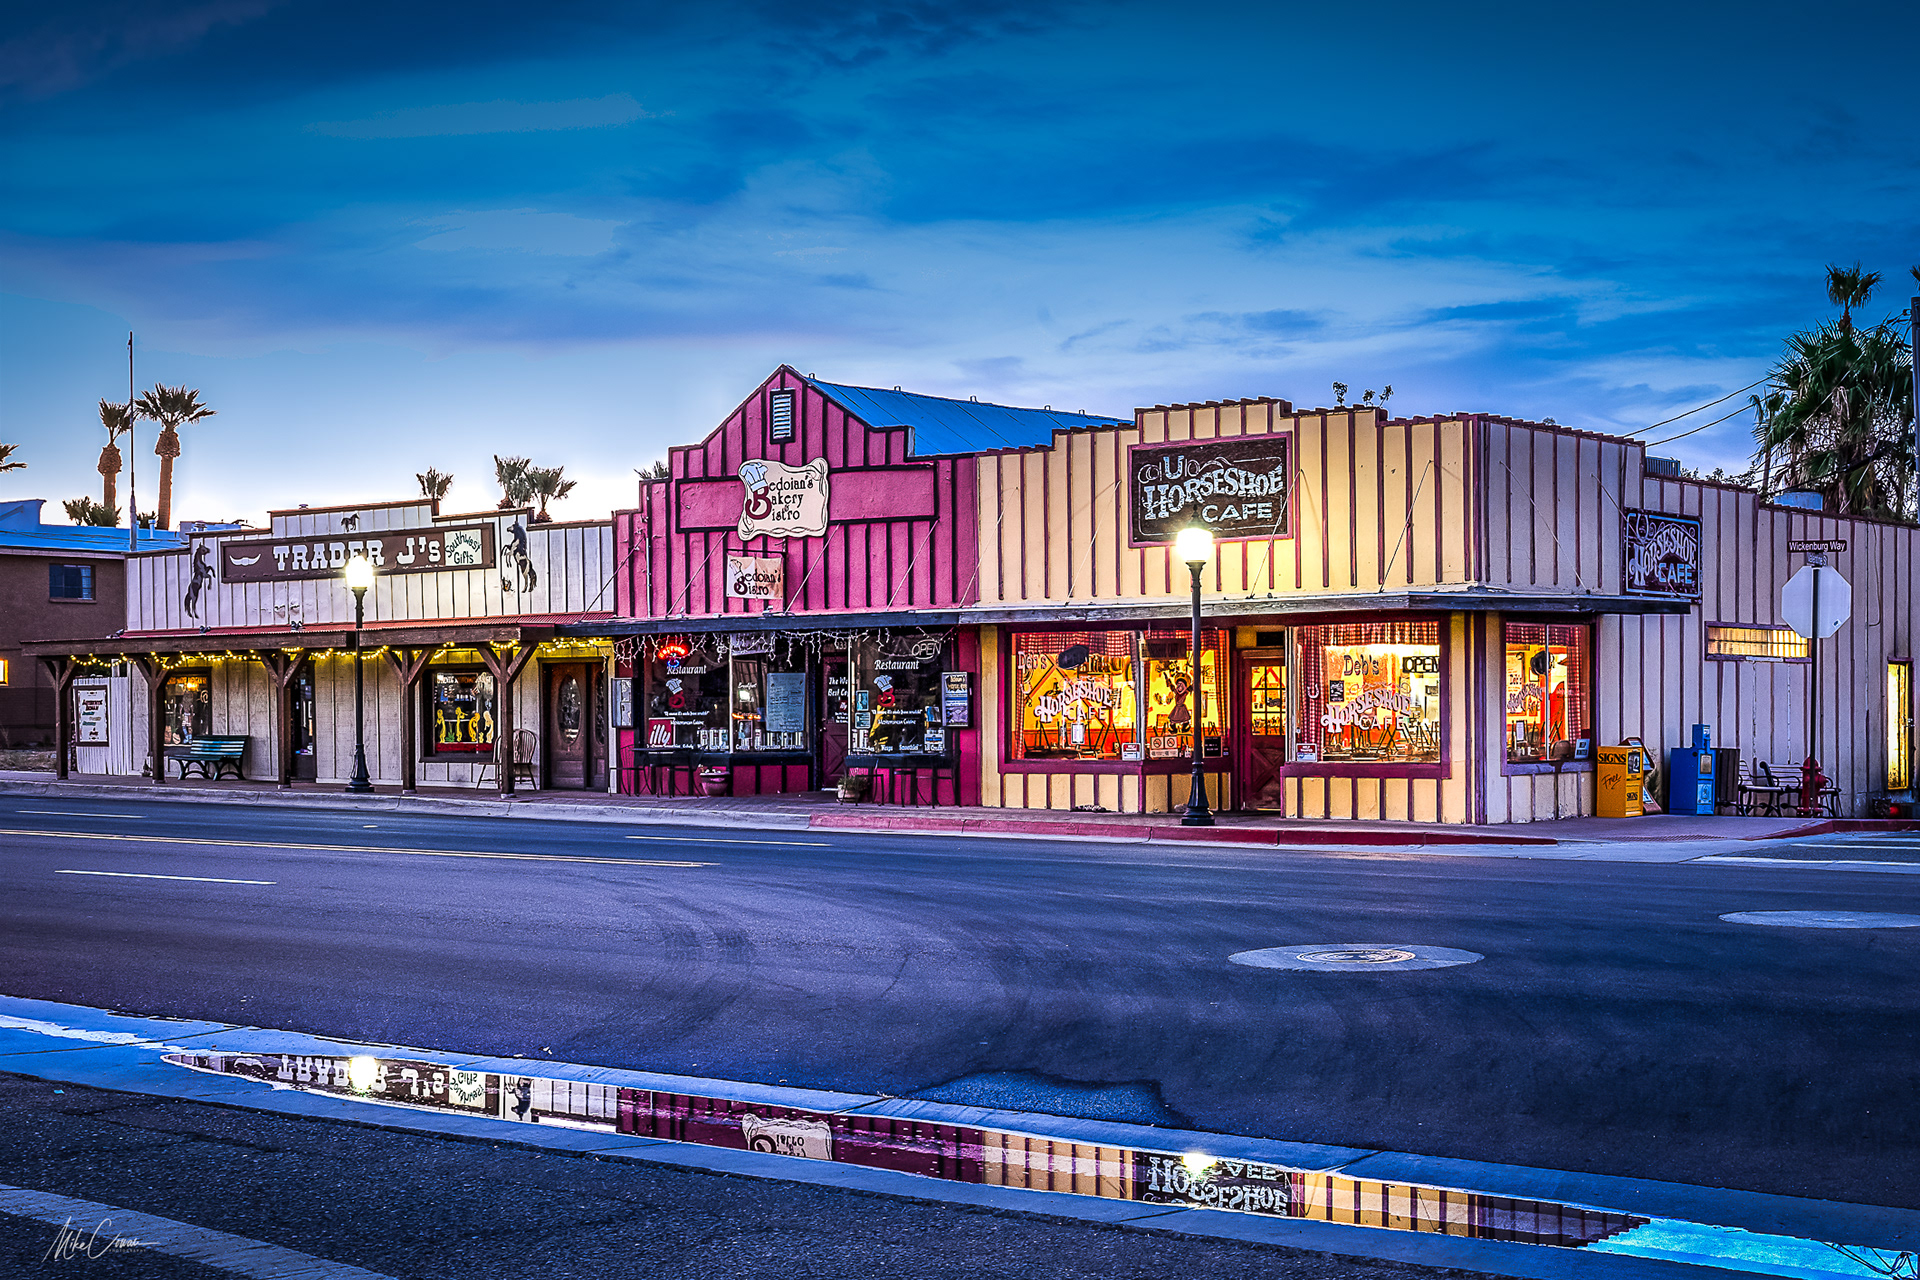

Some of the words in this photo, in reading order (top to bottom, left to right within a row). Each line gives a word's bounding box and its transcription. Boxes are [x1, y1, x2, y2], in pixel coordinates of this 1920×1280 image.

[1142, 464, 1284, 520] HORSESHOE
[1202, 502, 1273, 523] CAFE
[397, 536, 441, 565] J's
[1788, 541, 1828, 552] Wickenburg
[1829, 541, 1846, 552] Way
[454, 551, 475, 565] Gifts
[1629, 528, 1697, 587] HORSESHOE
[1658, 563, 1692, 584] CAFE
[912, 641, 941, 657] OPEN
[874, 660, 919, 670] Restaurant
[1018, 651, 1047, 669] Deb's
[1344, 655, 1379, 676] Deb's
[1403, 656, 1440, 673] OPEN
[667, 665, 707, 675] Restaurant
[1034, 680, 1113, 723] HORSESHOE
[1065, 706, 1107, 720] CAFE
[1321, 689, 1411, 734] HORSESHOE
[1360, 716, 1405, 731] CAFE
[650, 724, 671, 746] illy
[1598, 753, 1626, 763] SIGNS
[1601, 773, 1622, 790] Free
